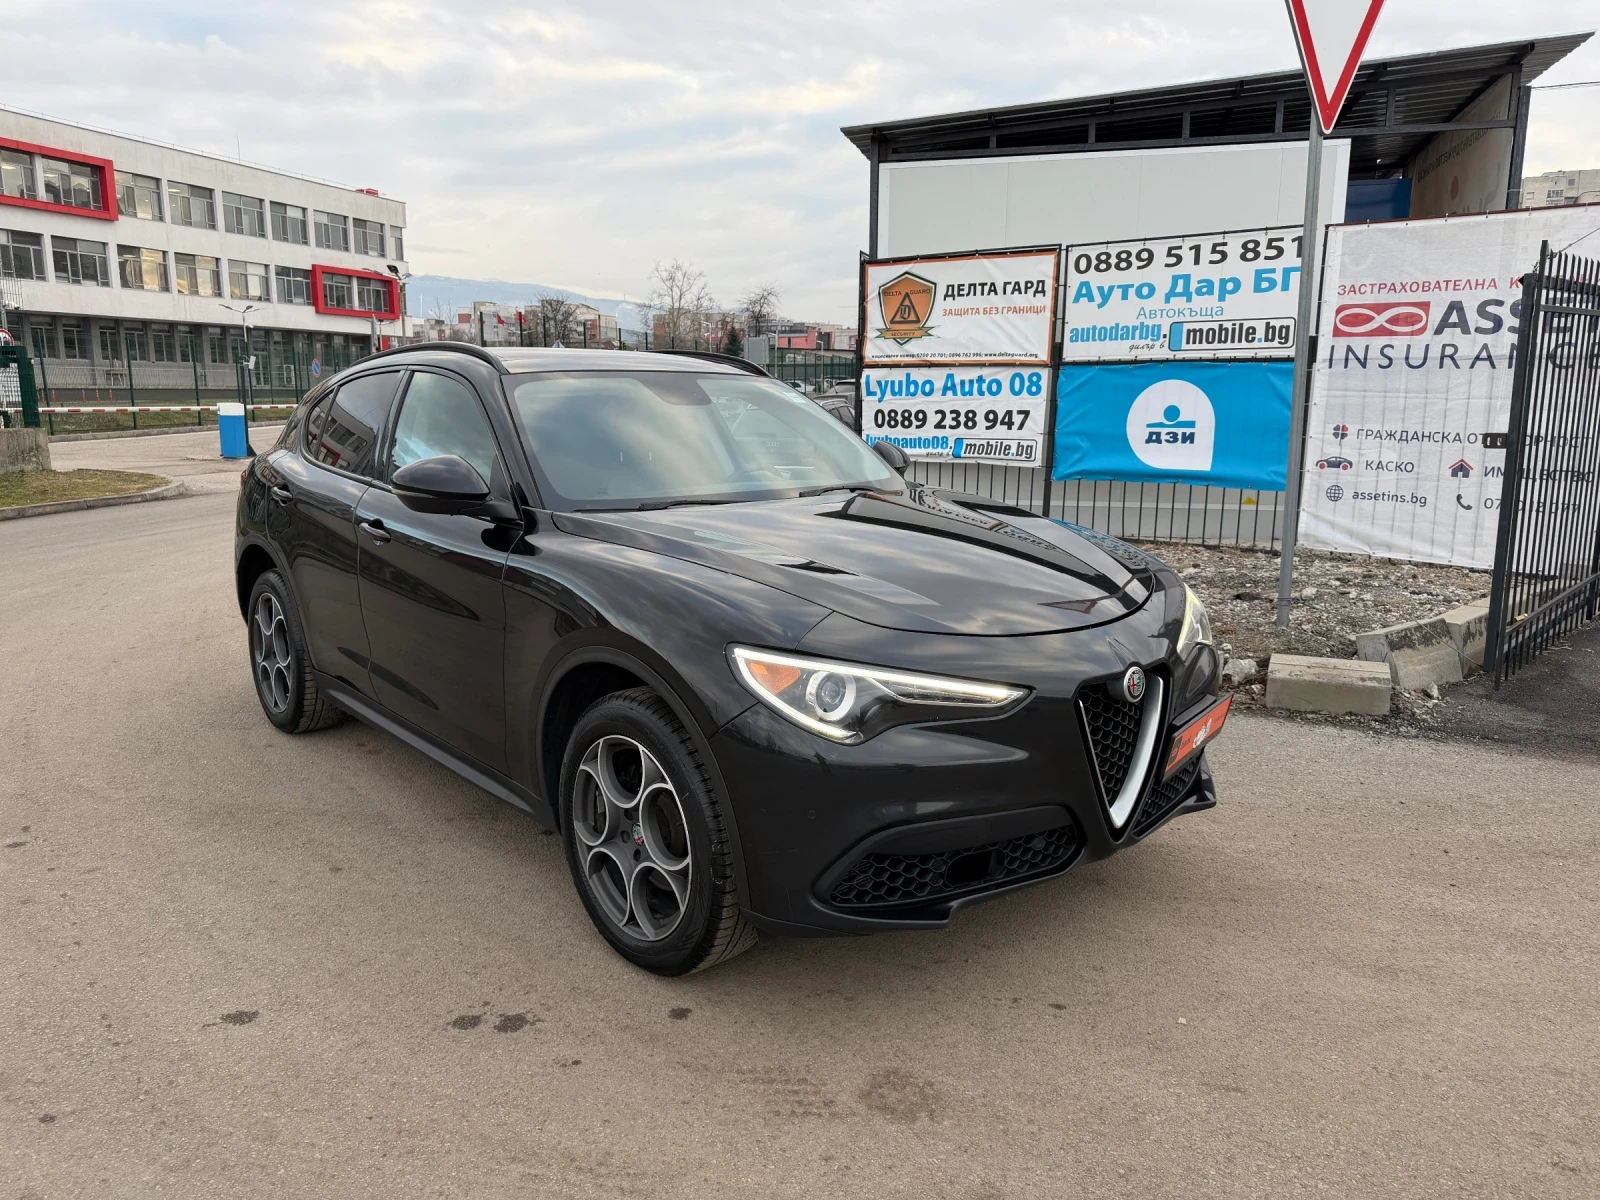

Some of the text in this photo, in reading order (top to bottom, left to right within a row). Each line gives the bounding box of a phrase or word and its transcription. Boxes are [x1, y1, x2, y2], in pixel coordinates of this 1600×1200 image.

[1074, 236, 1303, 274] 0889 515 851
[944, 279, 1046, 301] ДЕЛТА ГАРД
[1072, 266, 1302, 309] Ауто Дар БГ
[1337, 278, 1498, 296] ЗАСТРАХОВАТЕЛНА
[942, 305, 1046, 317] ЗАЩИТА БЕЗ ГРАНИЦИ
[1136, 305, 1224, 320] Автокъща
[1186, 322, 1291, 345] mobile.bg
[865, 372, 1042, 403] Lyubo Auto 08
[874, 408, 1031, 431] 0889 238 947
[1145, 431, 1196, 444] ДЗИ
[1356, 428, 1462, 444] ГРАЖДАНСКА
[963, 440, 1034, 460] mobile.bg
[1365, 460, 1414, 473] КАСКО
[1352, 490, 1428, 508] assetins.bg
